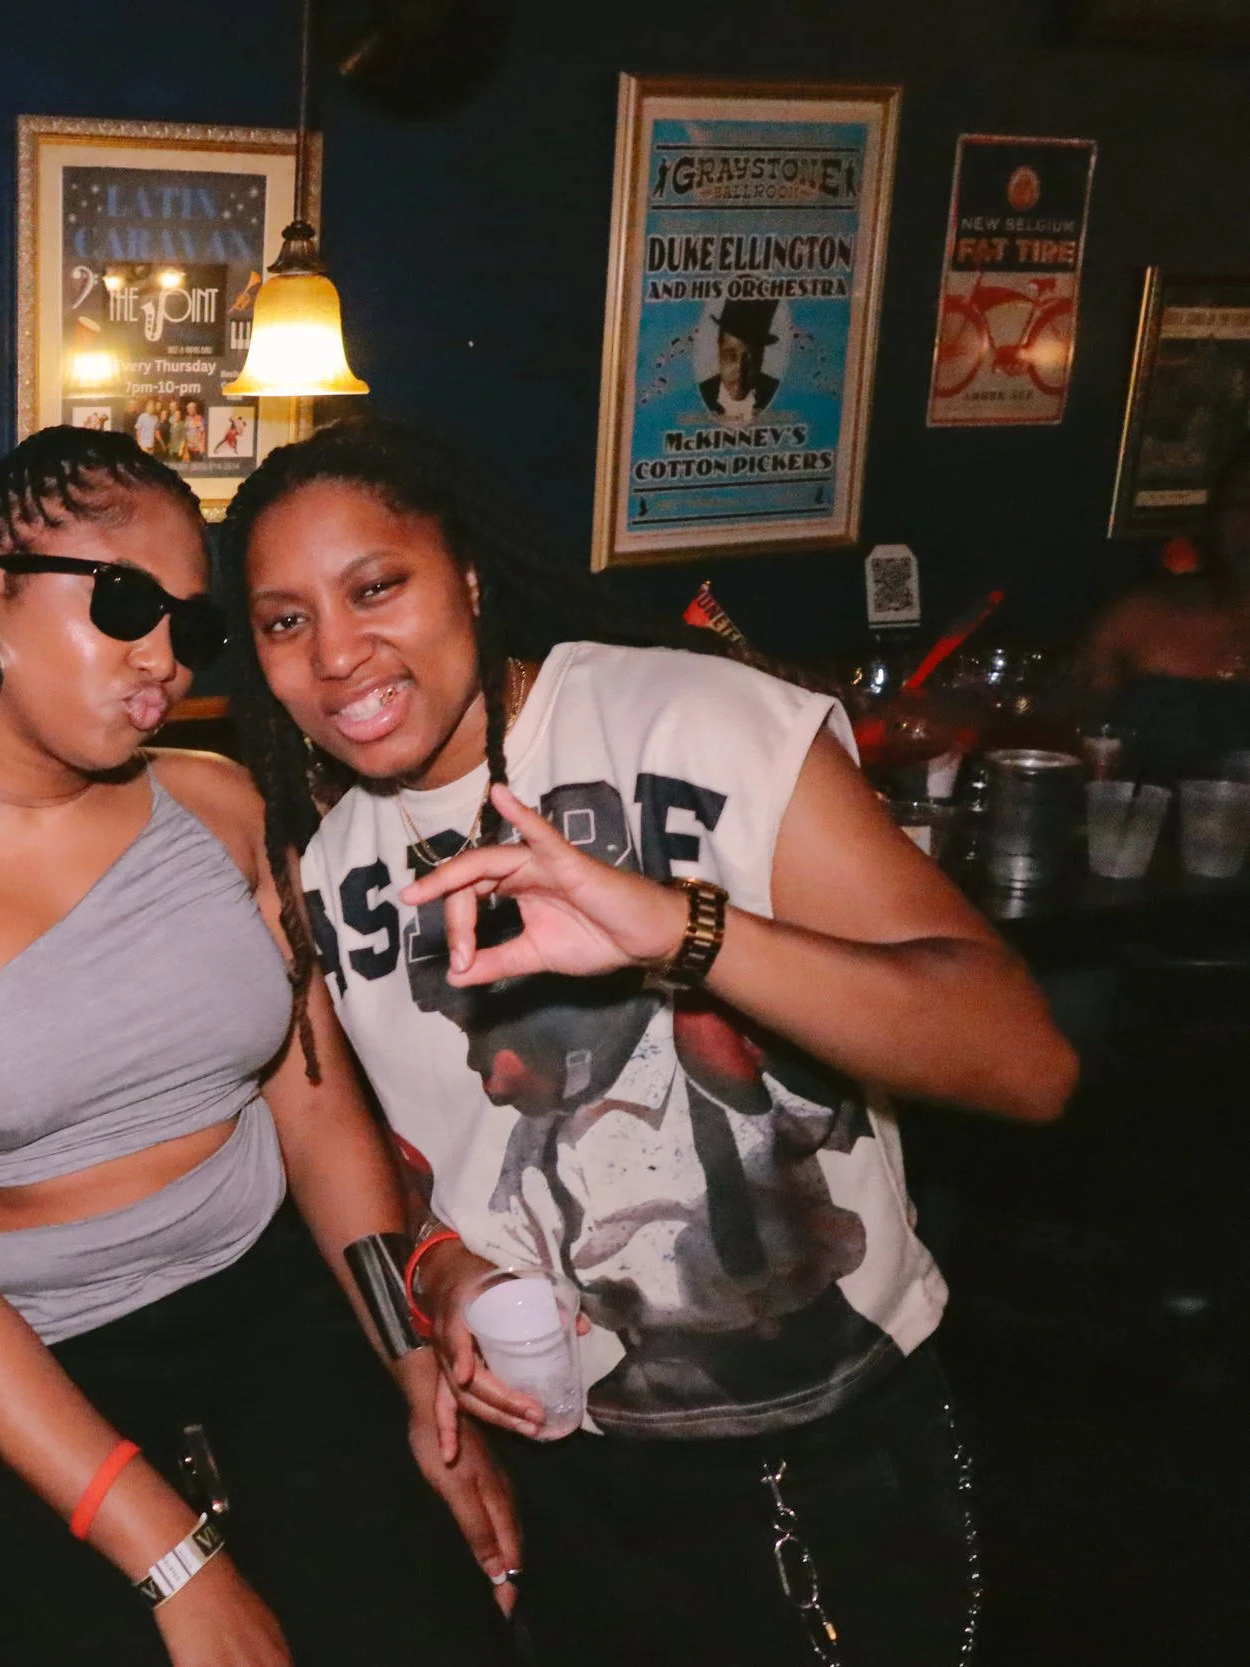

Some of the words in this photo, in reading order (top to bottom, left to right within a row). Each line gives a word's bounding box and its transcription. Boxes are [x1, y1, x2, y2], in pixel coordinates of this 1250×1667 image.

[672, 156, 842, 197] GRAYSTONE
[106, 185, 219, 219] LATIN
[713, 184, 799, 200] BALLROOM
[961, 217, 1000, 232] NEW
[1005, 217, 1076, 233] BELGIUM
[73, 226, 254, 260] CARAVAN
[648, 236, 715, 272] DUKE
[719, 235, 852, 272] ELLINGTON
[957, 237, 1009, 263] FAT
[1016, 239, 1077, 265] TIRE
[648, 280, 687, 300] AND
[691, 280, 723, 299] HIS
[727, 275, 847, 299] ORCHESTRA
[108, 286, 140, 322] THE
[119, 361, 152, 375] very
[154, 359, 217, 376] Thursday
[635, 457, 727, 481] COTTON
[732, 451, 833, 475] PICKERS
